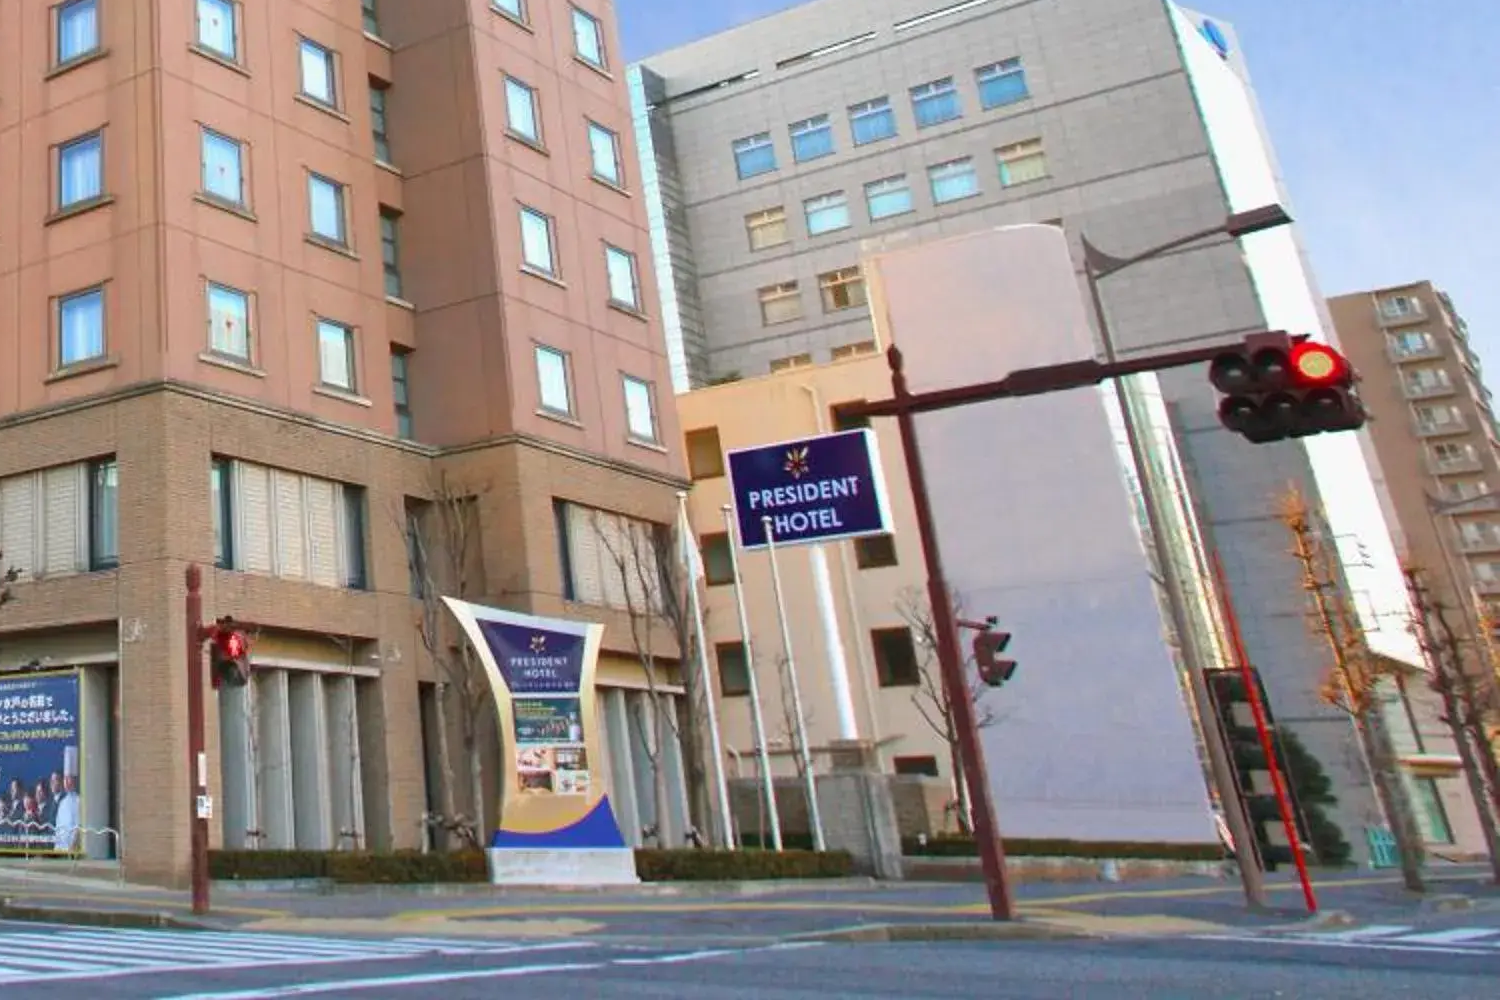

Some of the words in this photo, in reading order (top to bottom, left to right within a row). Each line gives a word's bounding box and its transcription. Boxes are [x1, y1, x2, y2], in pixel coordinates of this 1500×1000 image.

[749, 475, 859, 510] PRESIDENT
[774, 507, 844, 535] HOTEL
[510, 656, 569, 668] PRESIDENT
[523, 668, 557, 679] HOTEL
